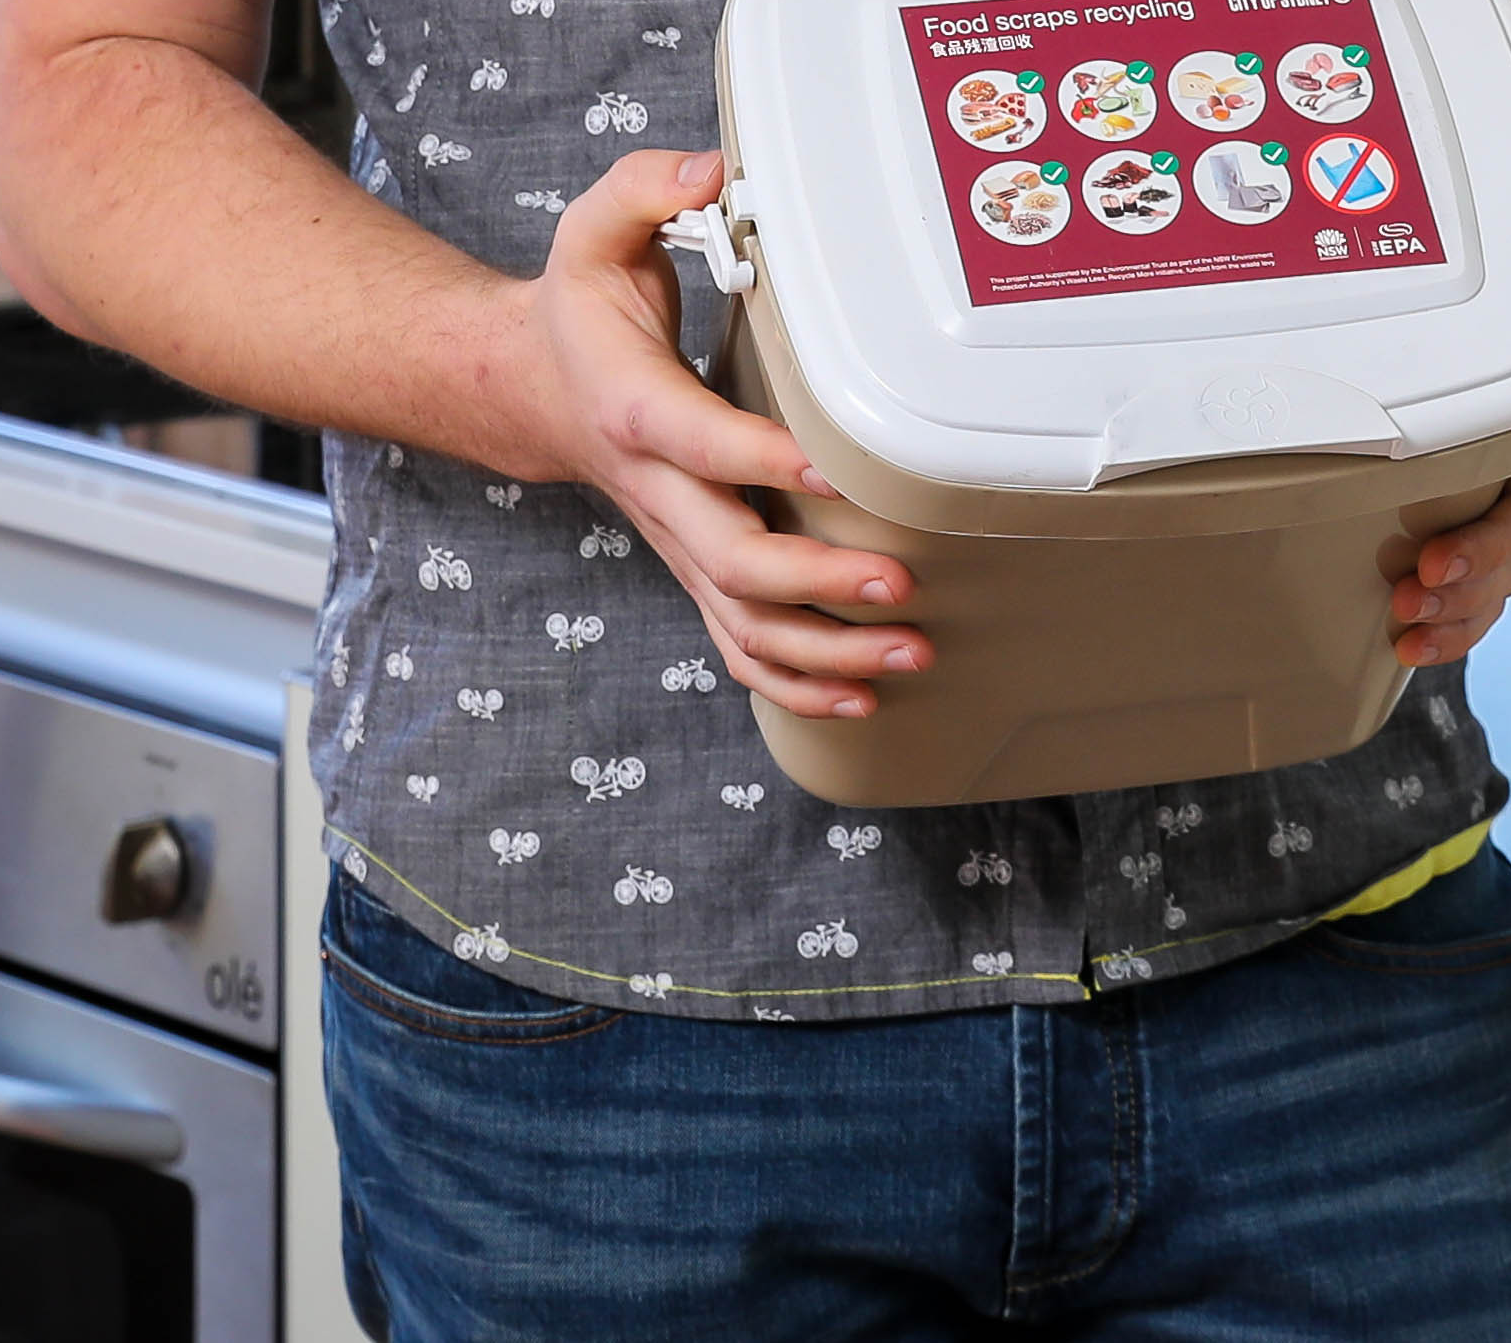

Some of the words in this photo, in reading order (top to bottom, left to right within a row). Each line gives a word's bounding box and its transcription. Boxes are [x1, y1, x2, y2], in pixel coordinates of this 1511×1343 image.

[923, 13, 989, 38] Food
[995, 7, 1078, 31] scraps
[929, 33, 1034, 58] 食品残渣回收
[1317, 244, 1348, 257] NSW
[1379, 237, 1427, 256] EPA
[992, 283, 1028, 292] Protection
[1107, 273, 1136, 281] Recycle
[1186, 265, 1210, 274] funded
[1211, 263, 1228, 271] from
[1241, 260, 1260, 269] waste
[1005, 275, 1029, 284] project
[1178, 259, 1193, 267] part
[1231, 252, 1273, 261] Environment
